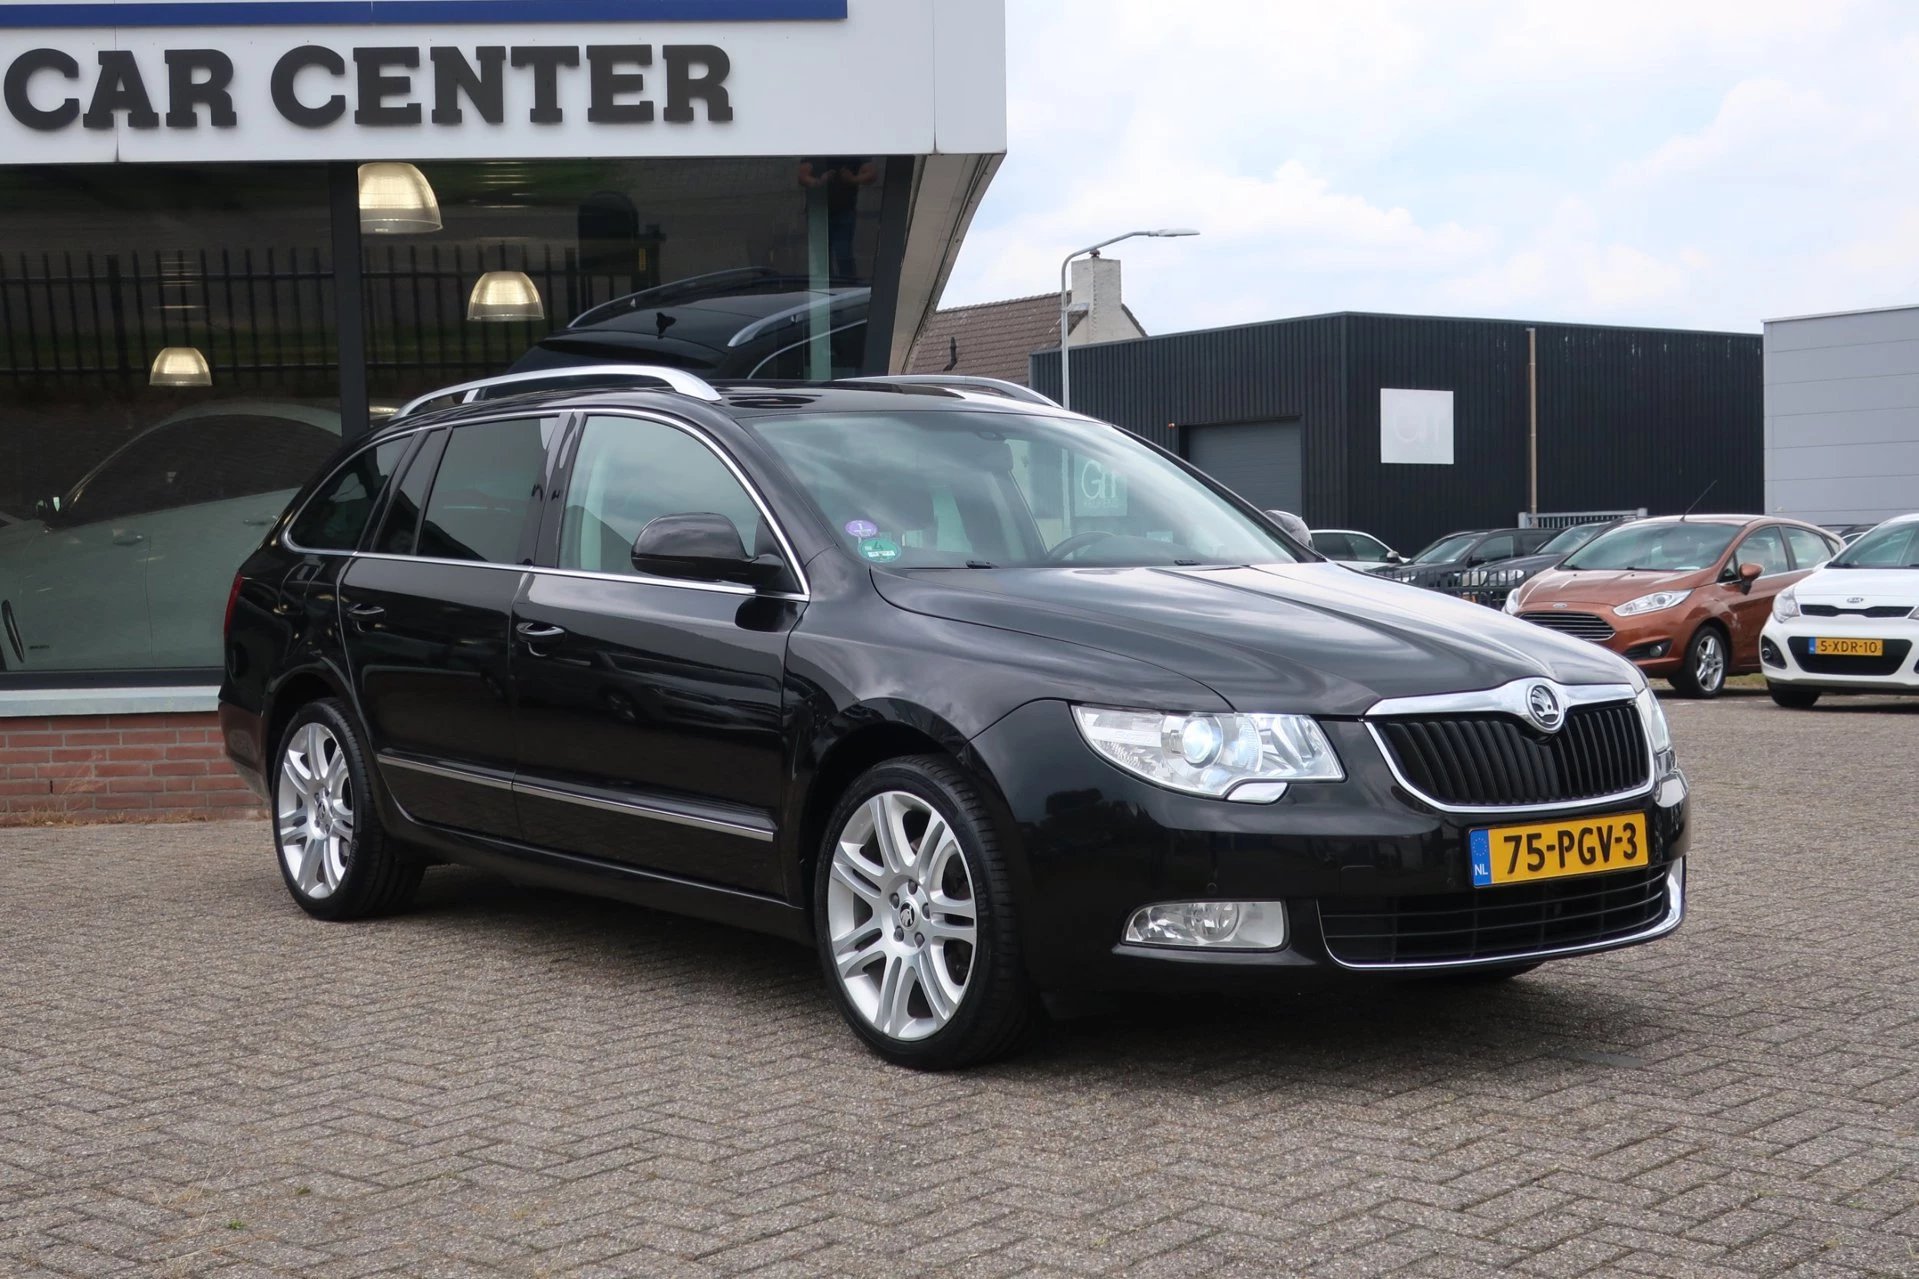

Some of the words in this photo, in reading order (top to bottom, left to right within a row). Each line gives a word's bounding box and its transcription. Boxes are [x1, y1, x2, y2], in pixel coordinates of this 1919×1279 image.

[3, 47, 237, 131] CAR
[270, 44, 733, 128] CENTER
[1820, 640, 1878, 654] 5-XDR-10
[1503, 822, 1638, 875] 75-PGV-3
[1474, 863, 1489, 876] NL
